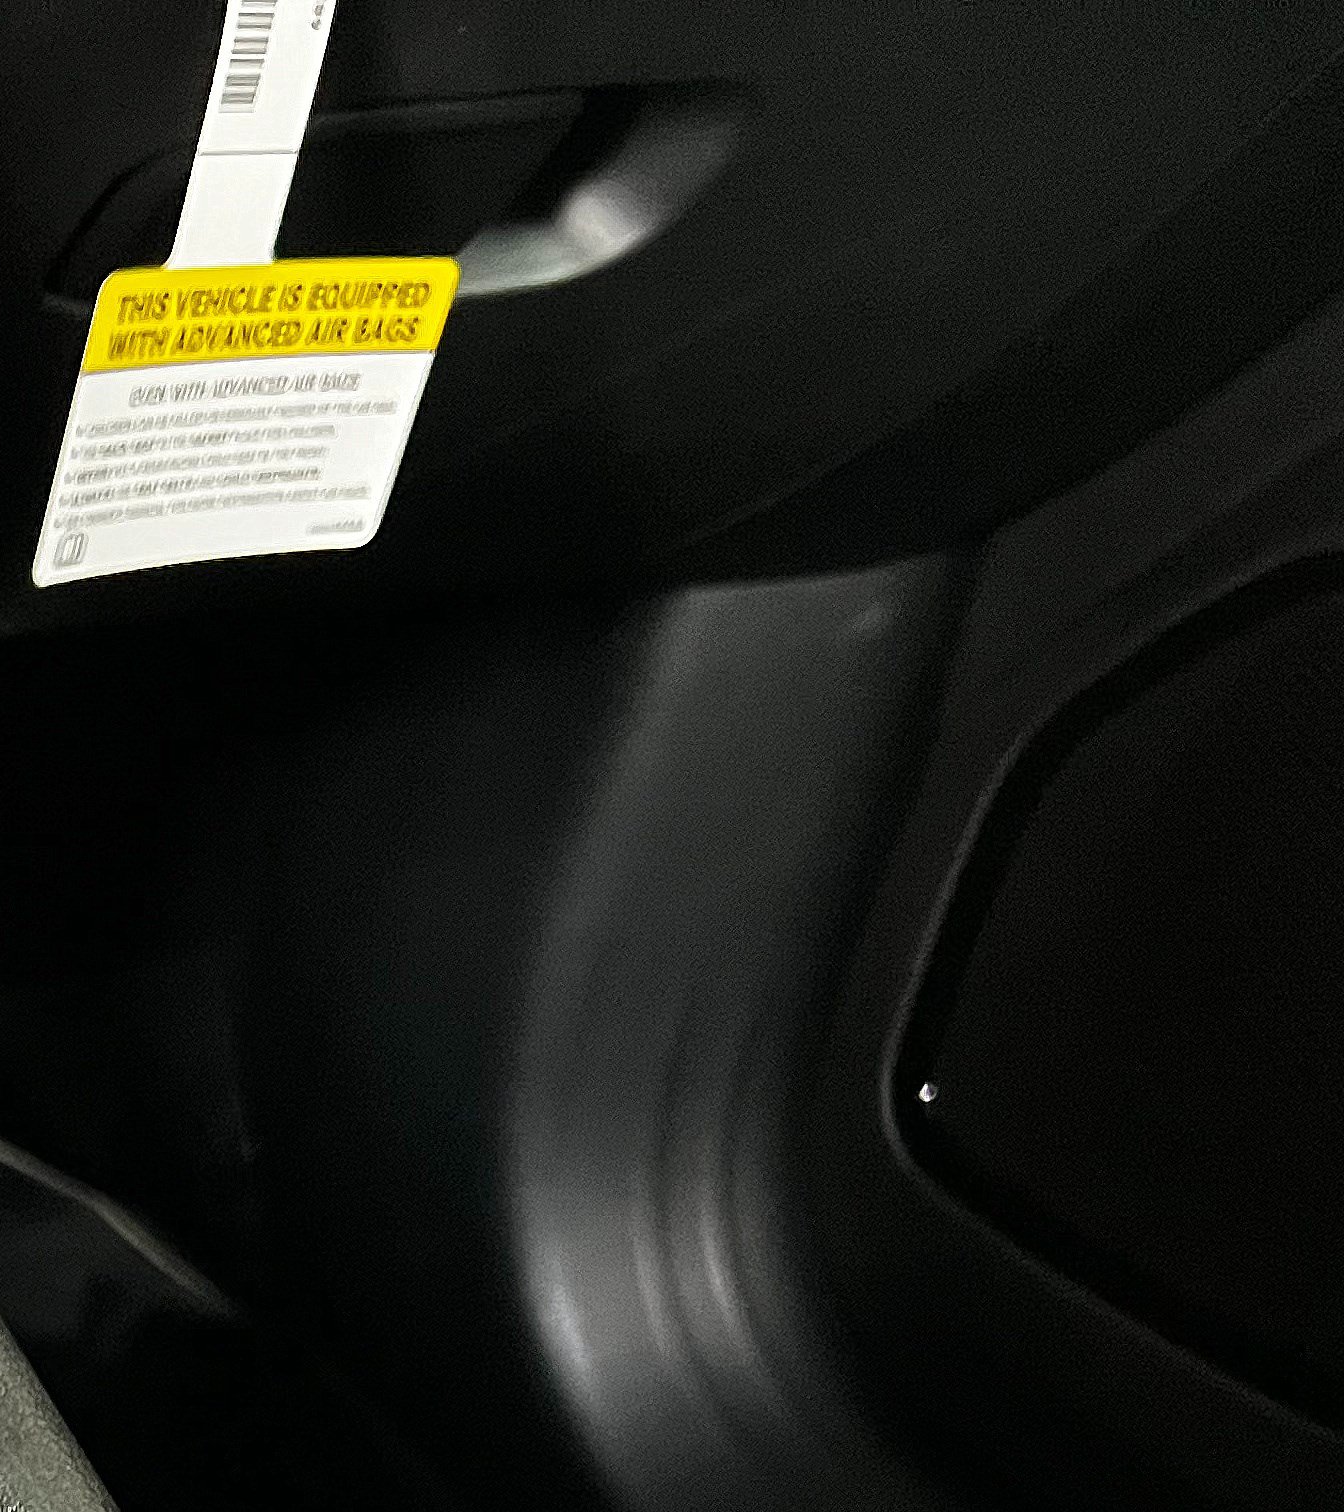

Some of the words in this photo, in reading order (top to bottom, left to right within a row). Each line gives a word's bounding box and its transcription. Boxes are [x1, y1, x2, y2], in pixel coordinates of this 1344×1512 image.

[117, 291, 169, 323] THIS
[175, 285, 276, 319] VEHICLE
[278, 283, 303, 311] IS
[306, 281, 430, 311] EQUIPPED
[109, 326, 170, 360] WITH
[171, 319, 302, 354] ADVANCED
[305, 317, 347, 346] AIR
[351, 315, 418, 344] BAGS
